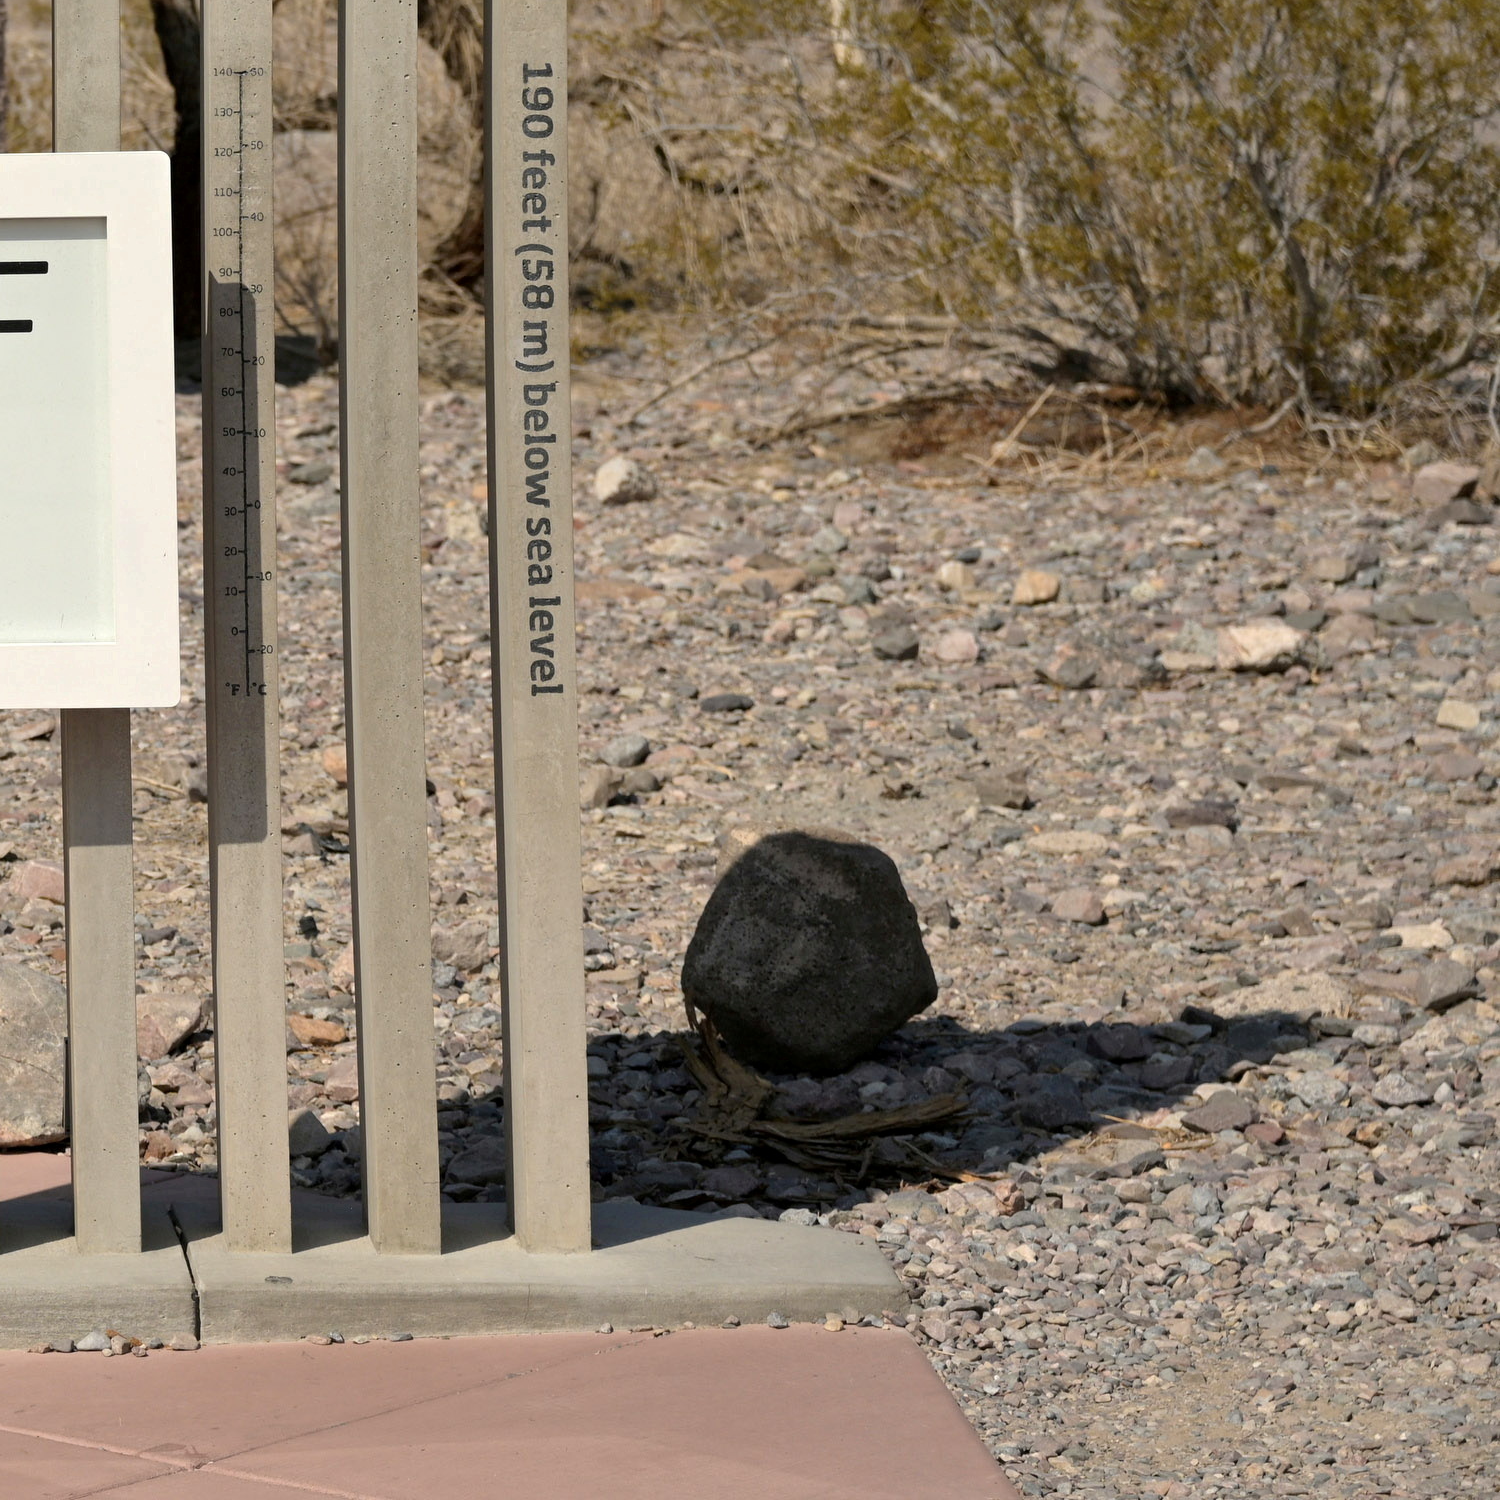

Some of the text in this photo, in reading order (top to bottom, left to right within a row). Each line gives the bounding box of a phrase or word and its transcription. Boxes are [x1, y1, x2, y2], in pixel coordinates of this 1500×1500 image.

[213, 67, 233, 77] 140
[250, 67, 264, 76] 60
[214, 107, 233, 117] 130
[250, 141, 264, 150] 50
[214, 147, 233, 157] 120
[214, 187, 233, 197] 110
[250, 212, 264, 222] 40
[213, 228, 233, 237] 100
[219, 267, 233, 277] 90
[250, 284, 263, 294] 30
[219, 308, 233, 317] 80
[221, 348, 234, 357] 70
[252, 356, 265, 366] 20
[515, 63, 564, 697] 190 feet (58 m) below sea level
[221, 388, 235, 397] 60
[222, 427, 236, 437] 50
[253, 428, 266, 438] 10
[222, 467, 236, 477] 40
[254, 500, 261, 510] 0
[224, 507, 237, 516] 30
[224, 547, 237, 557] 20
[255, 571, 272, 581] -10
[224, 587, 238, 596] 10
[231, 627, 239, 636] 0
[256, 645, 273, 654] -20
